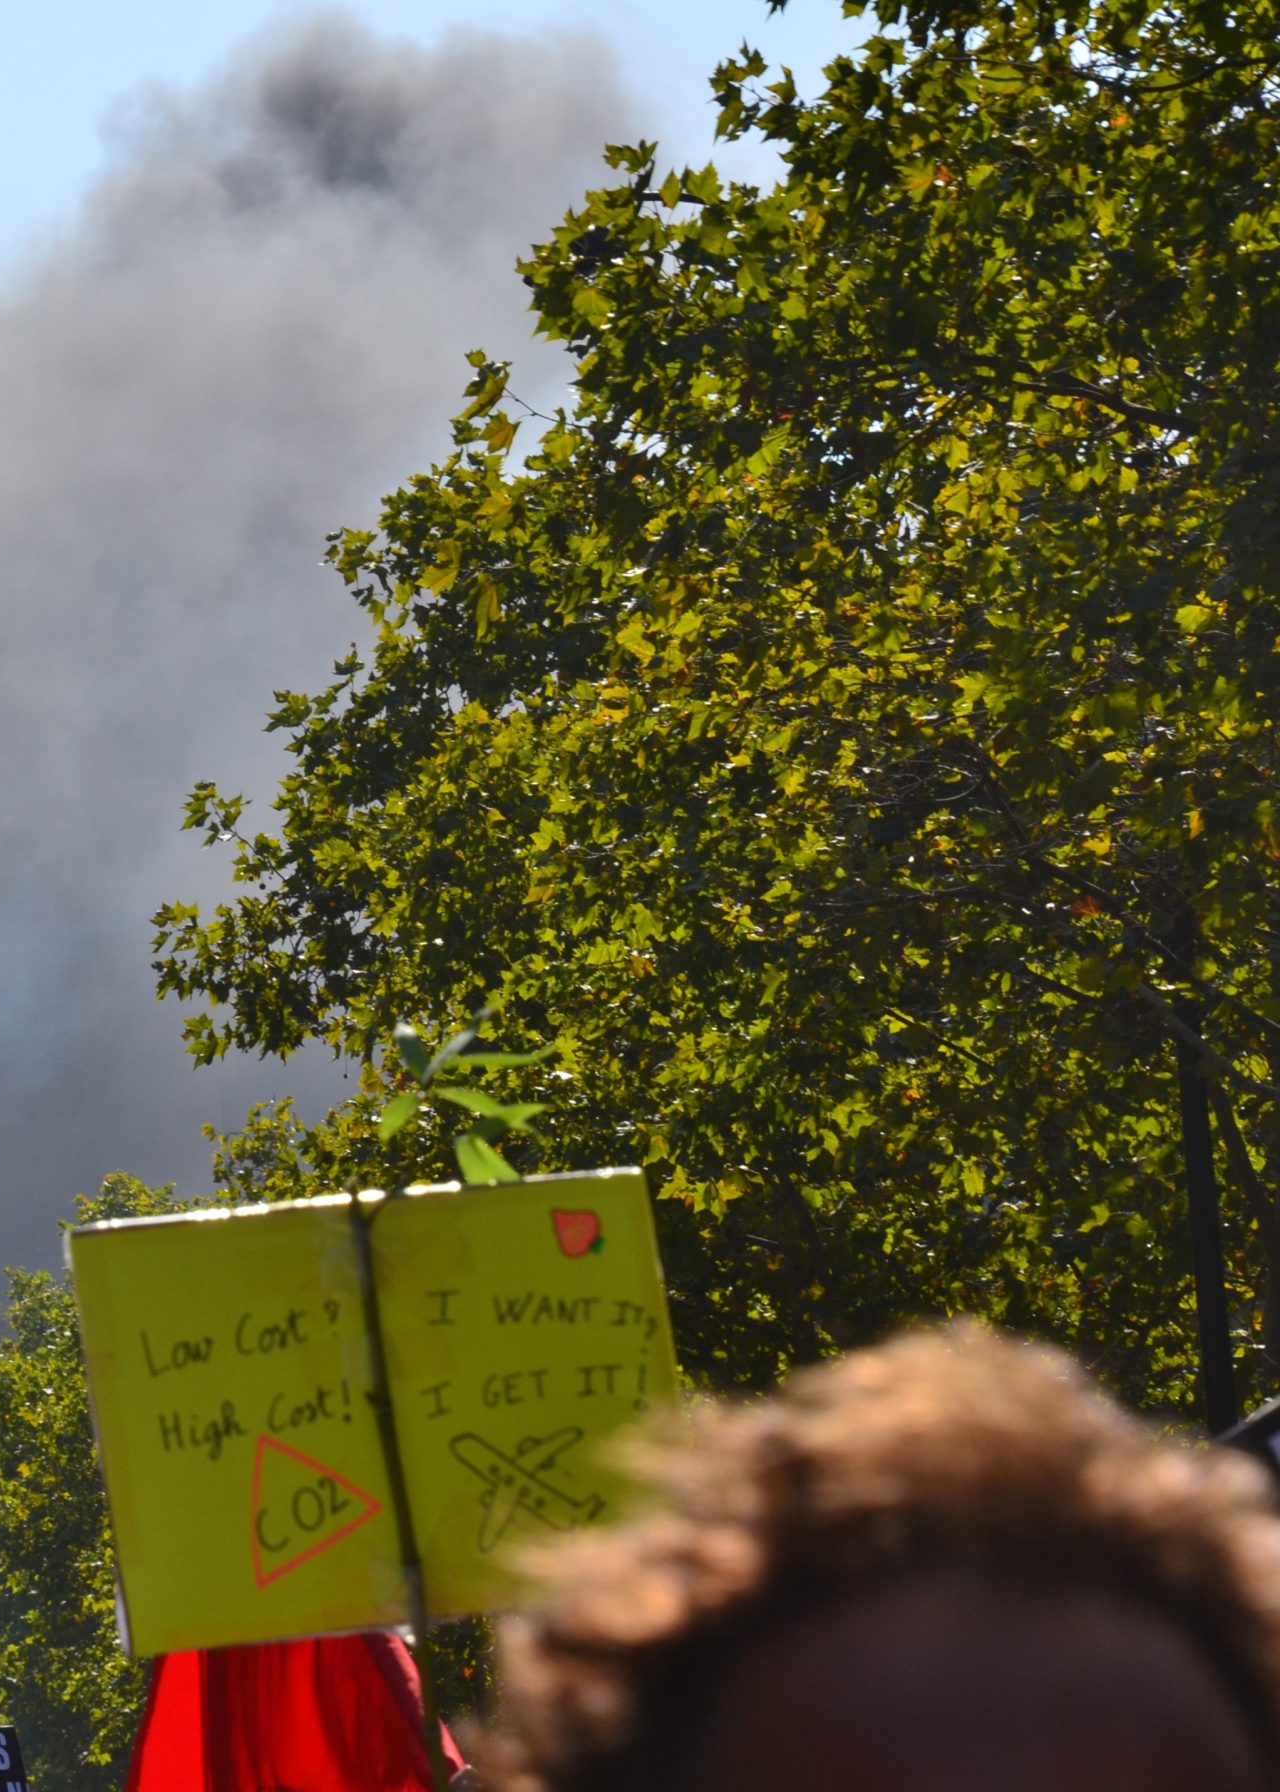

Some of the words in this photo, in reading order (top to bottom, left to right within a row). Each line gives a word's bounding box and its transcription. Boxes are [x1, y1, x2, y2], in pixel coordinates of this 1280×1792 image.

[426, 1289, 458, 1326] I
[493, 1290, 600, 1326] WANT
[140, 1328, 213, 1377] Low
[419, 1379, 452, 1419] I
[482, 1368, 549, 1409] GET
[158, 1399, 248, 1462] High
[256, 1476, 351, 1552] CO2
